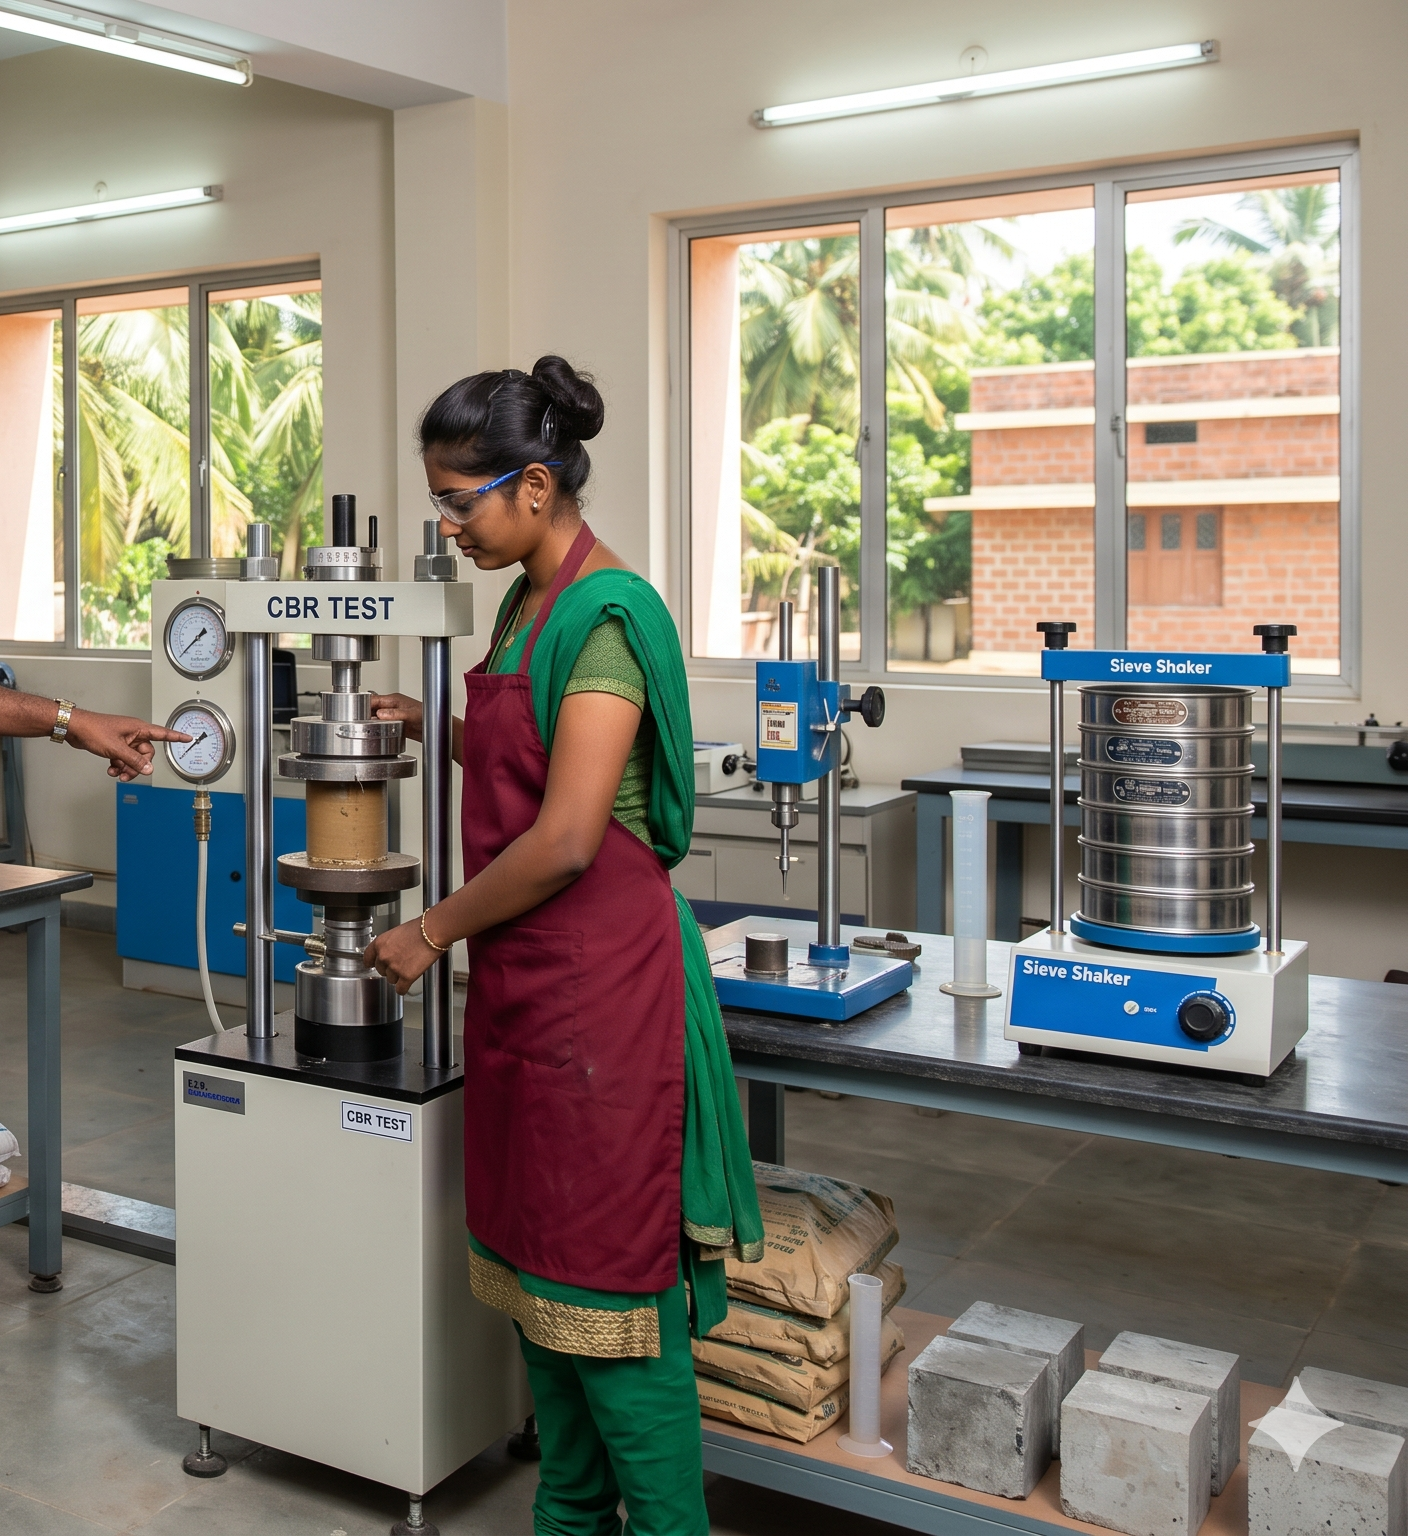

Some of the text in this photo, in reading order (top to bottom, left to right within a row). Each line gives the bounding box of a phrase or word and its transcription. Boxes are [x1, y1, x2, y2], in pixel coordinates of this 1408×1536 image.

[267, 595, 395, 620] CBR TEST
[1110, 658, 1213, 675] Sieve Shaker
[1023, 959, 1131, 986] Sieve Shaker
[346, 1110, 407, 1132] CBR TEST
